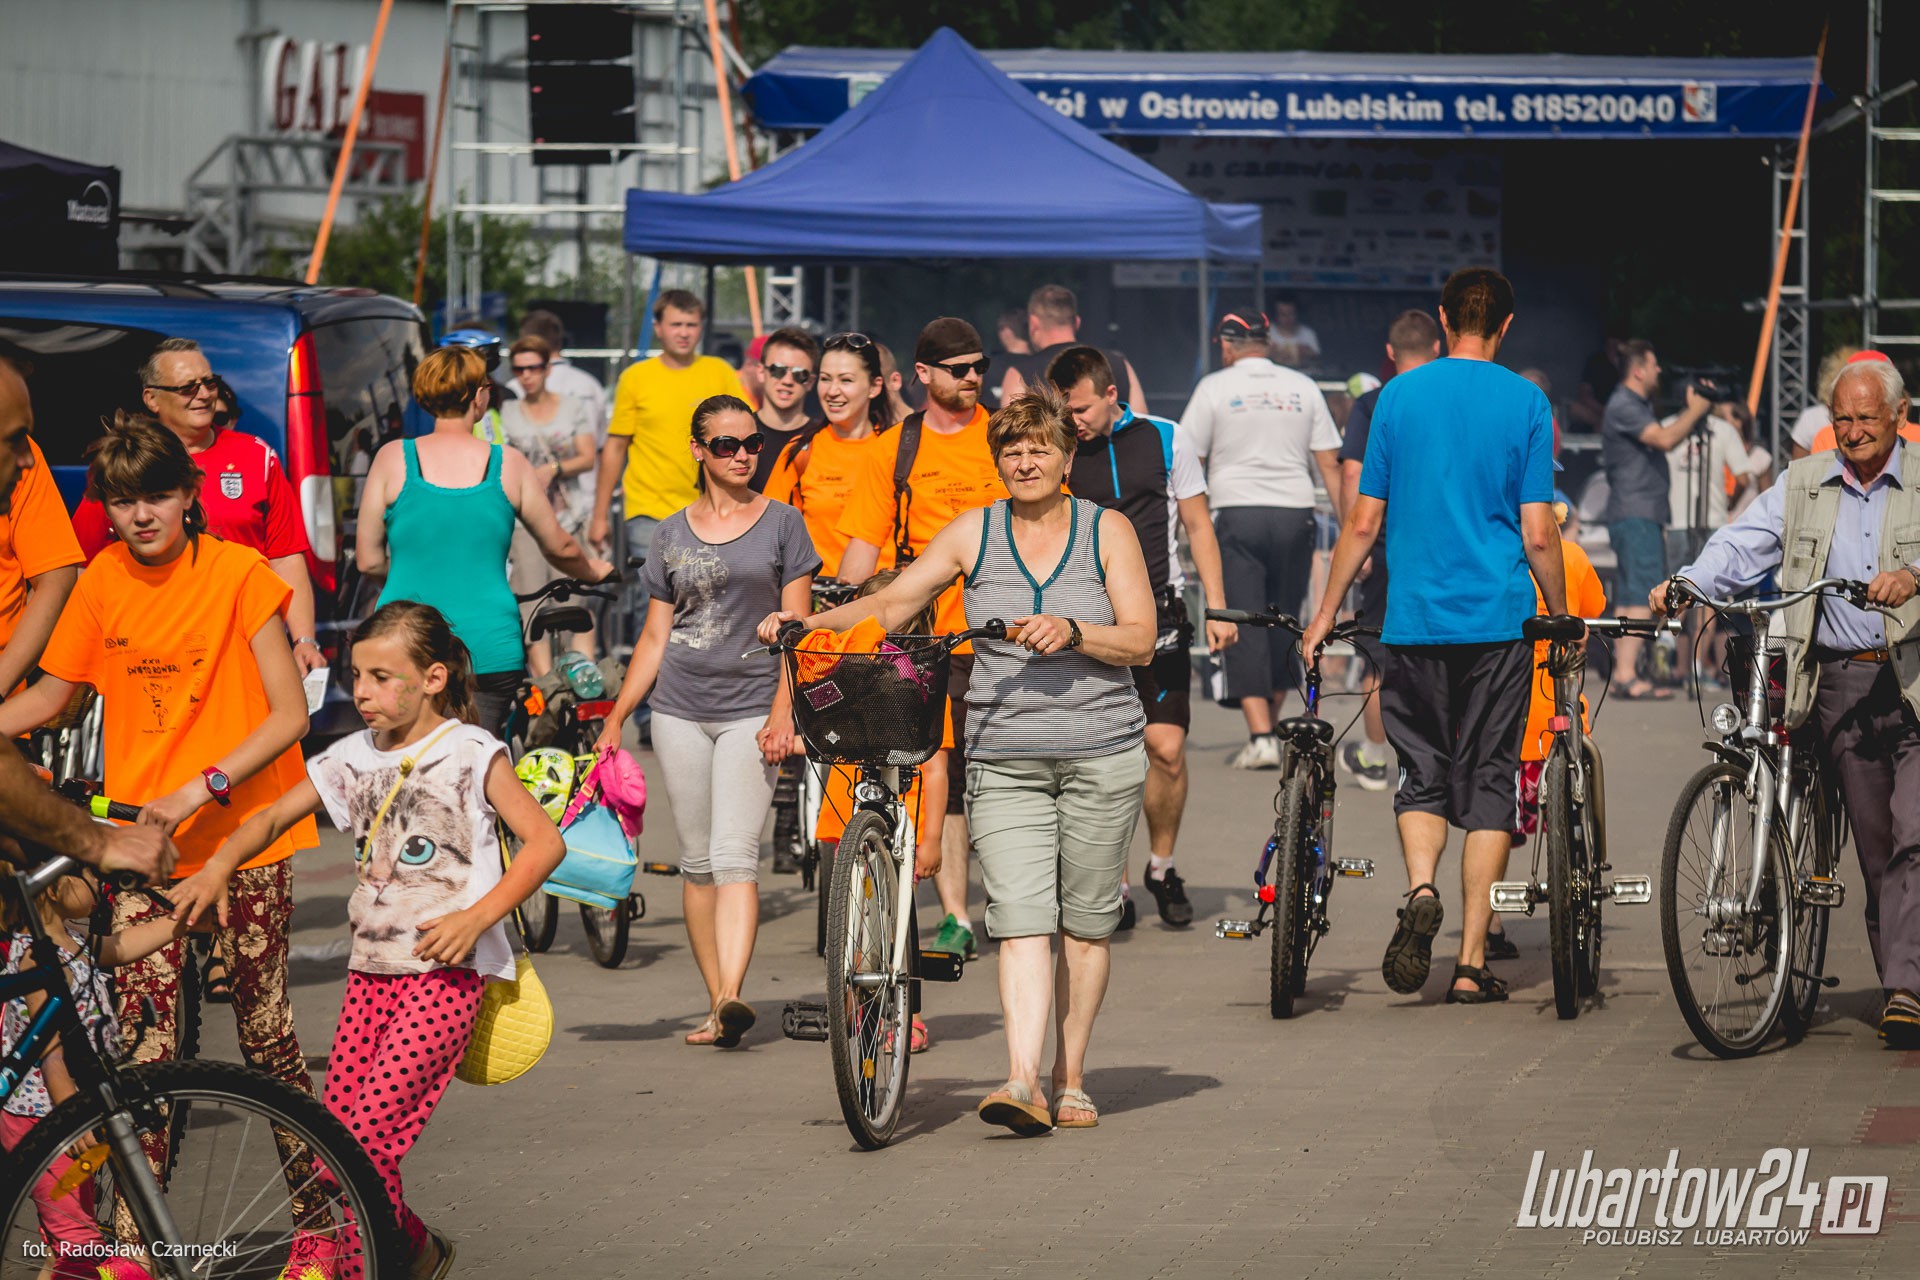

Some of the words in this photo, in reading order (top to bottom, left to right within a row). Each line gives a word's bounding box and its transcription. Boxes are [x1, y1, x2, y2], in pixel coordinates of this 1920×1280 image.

[1099, 97, 1128, 119] w
[1139, 91, 1279, 120] Ostrowie
[1286, 91, 1443, 121] Lubelskim
[1454, 94, 1506, 122] tel.
[1511, 94, 1675, 122] 818520040
